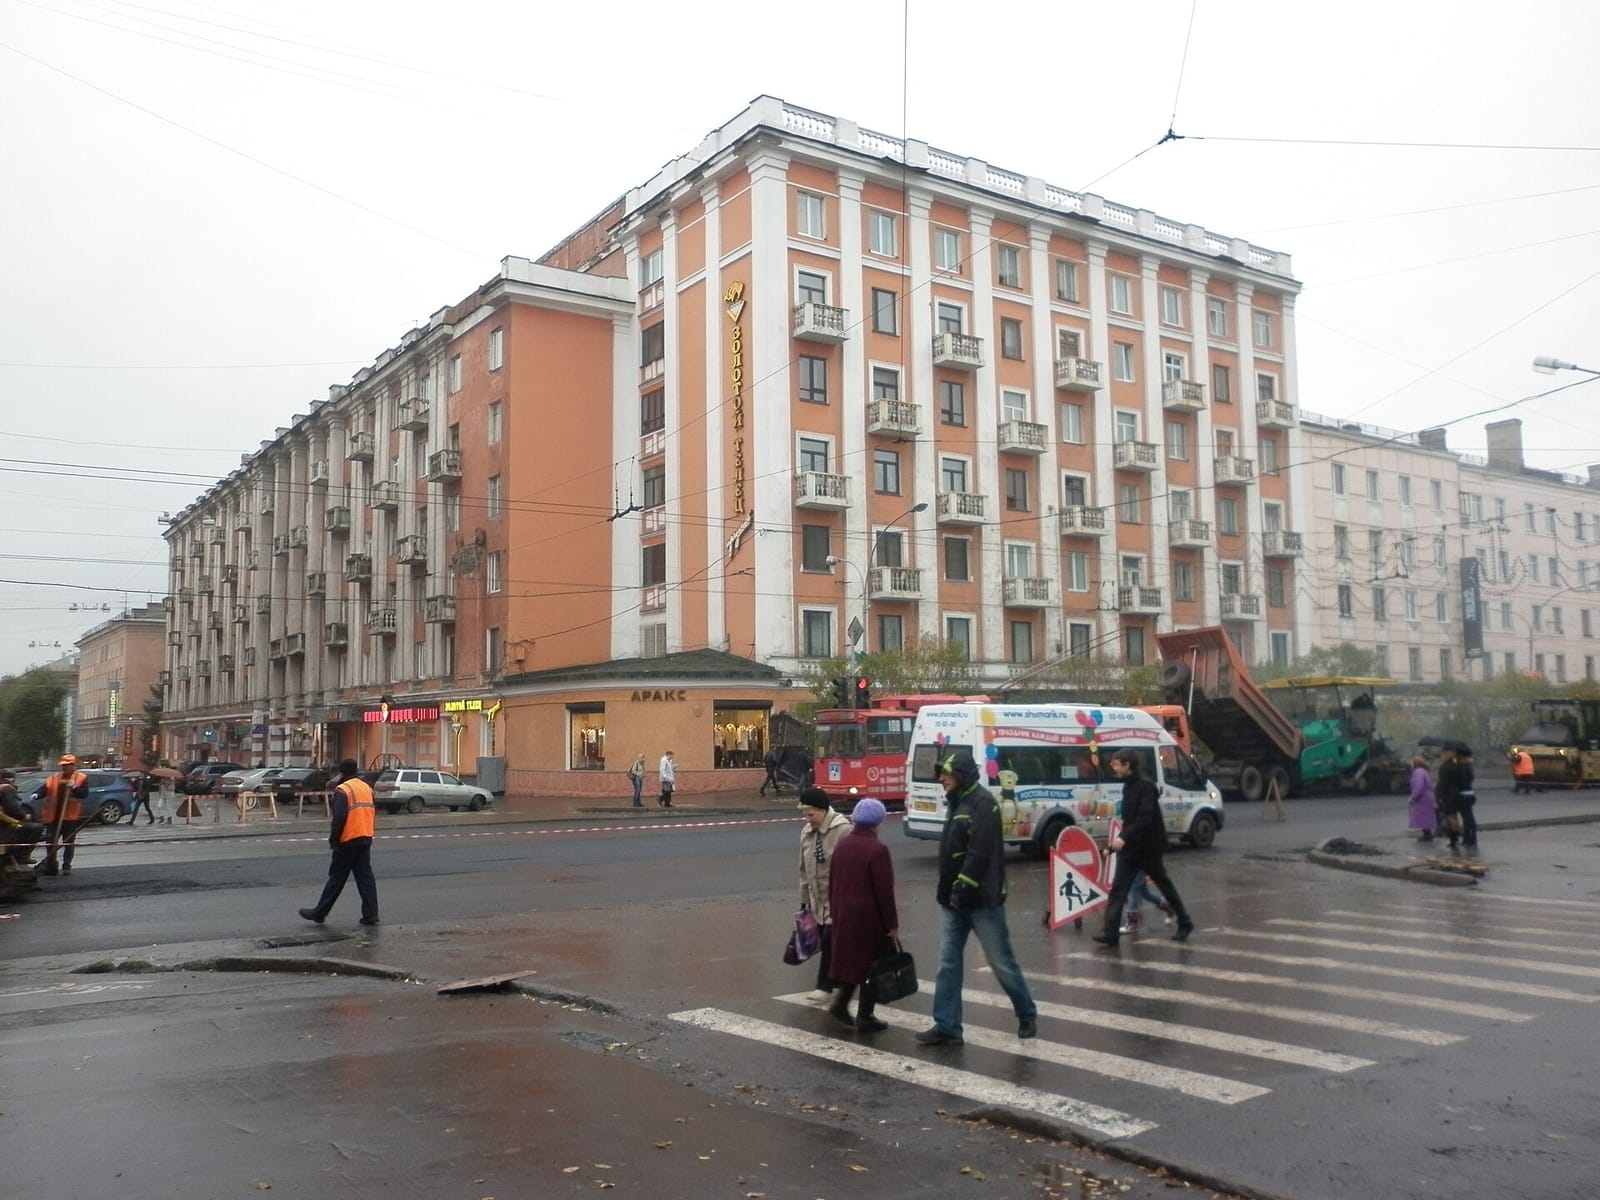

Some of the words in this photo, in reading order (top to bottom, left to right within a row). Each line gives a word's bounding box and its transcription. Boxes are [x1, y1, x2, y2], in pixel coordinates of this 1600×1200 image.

[731, 326, 744, 429] ЗОЛОТОЙ
[733, 438, 745, 513] ТЕЛЕЦ
[630, 690, 687, 702] АРАКС
[1003, 710, 1068, 719] www.shumarik.ru
